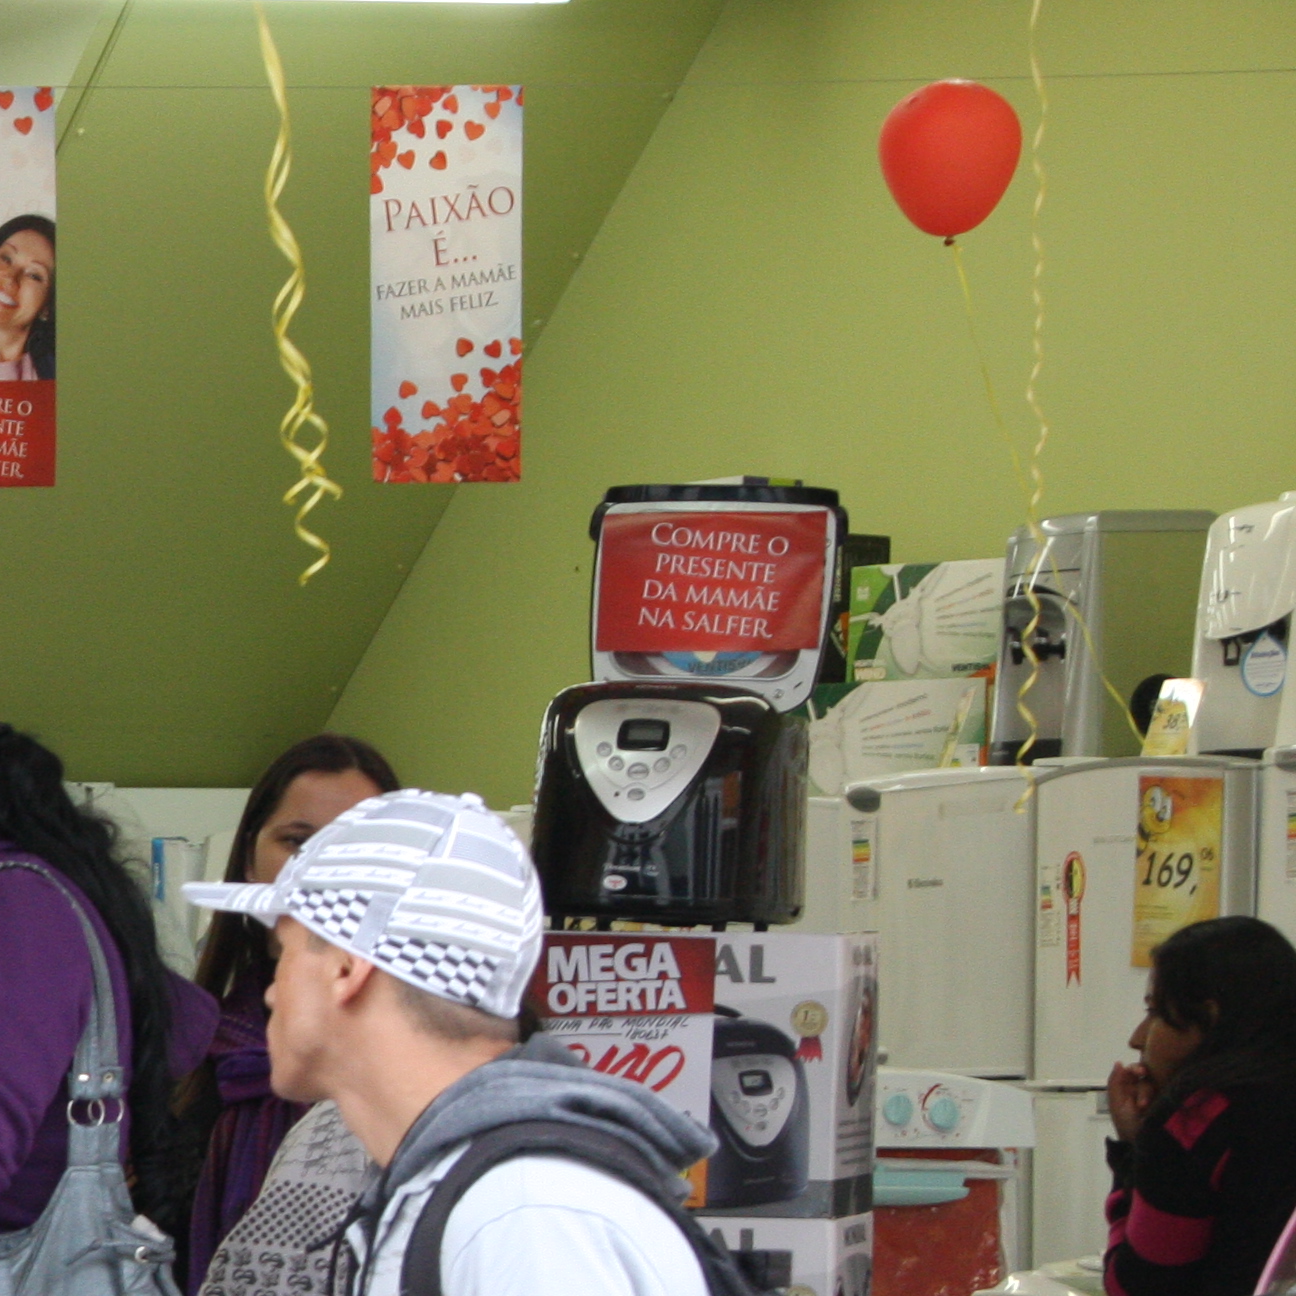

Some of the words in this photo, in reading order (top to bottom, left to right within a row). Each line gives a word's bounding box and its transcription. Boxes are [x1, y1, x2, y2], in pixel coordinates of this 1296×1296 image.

[384, 184, 515, 232] PAIXÃO
[432, 230, 477, 267] É...
[376, 279, 428, 301] FAZER
[434, 278, 446, 293] A
[451, 263, 517, 291] MAMÃE
[400, 300, 445, 320] MAIS
[17, 400, 32, 416] O
[651, 522, 760, 554] COMPRE
[768, 536, 789, 555] O
[655, 553, 776, 583] PRESENTE
[642, 579, 678, 601] DA
[685, 586, 780, 612] MAMÃE
[638, 607, 675, 628] NA
[682, 611, 773, 639] SALFER.
[548, 941, 681, 983] MEGA
[548, 980, 687, 1013] OFERTA
[622, 1015, 689, 1030] MONDIAL
